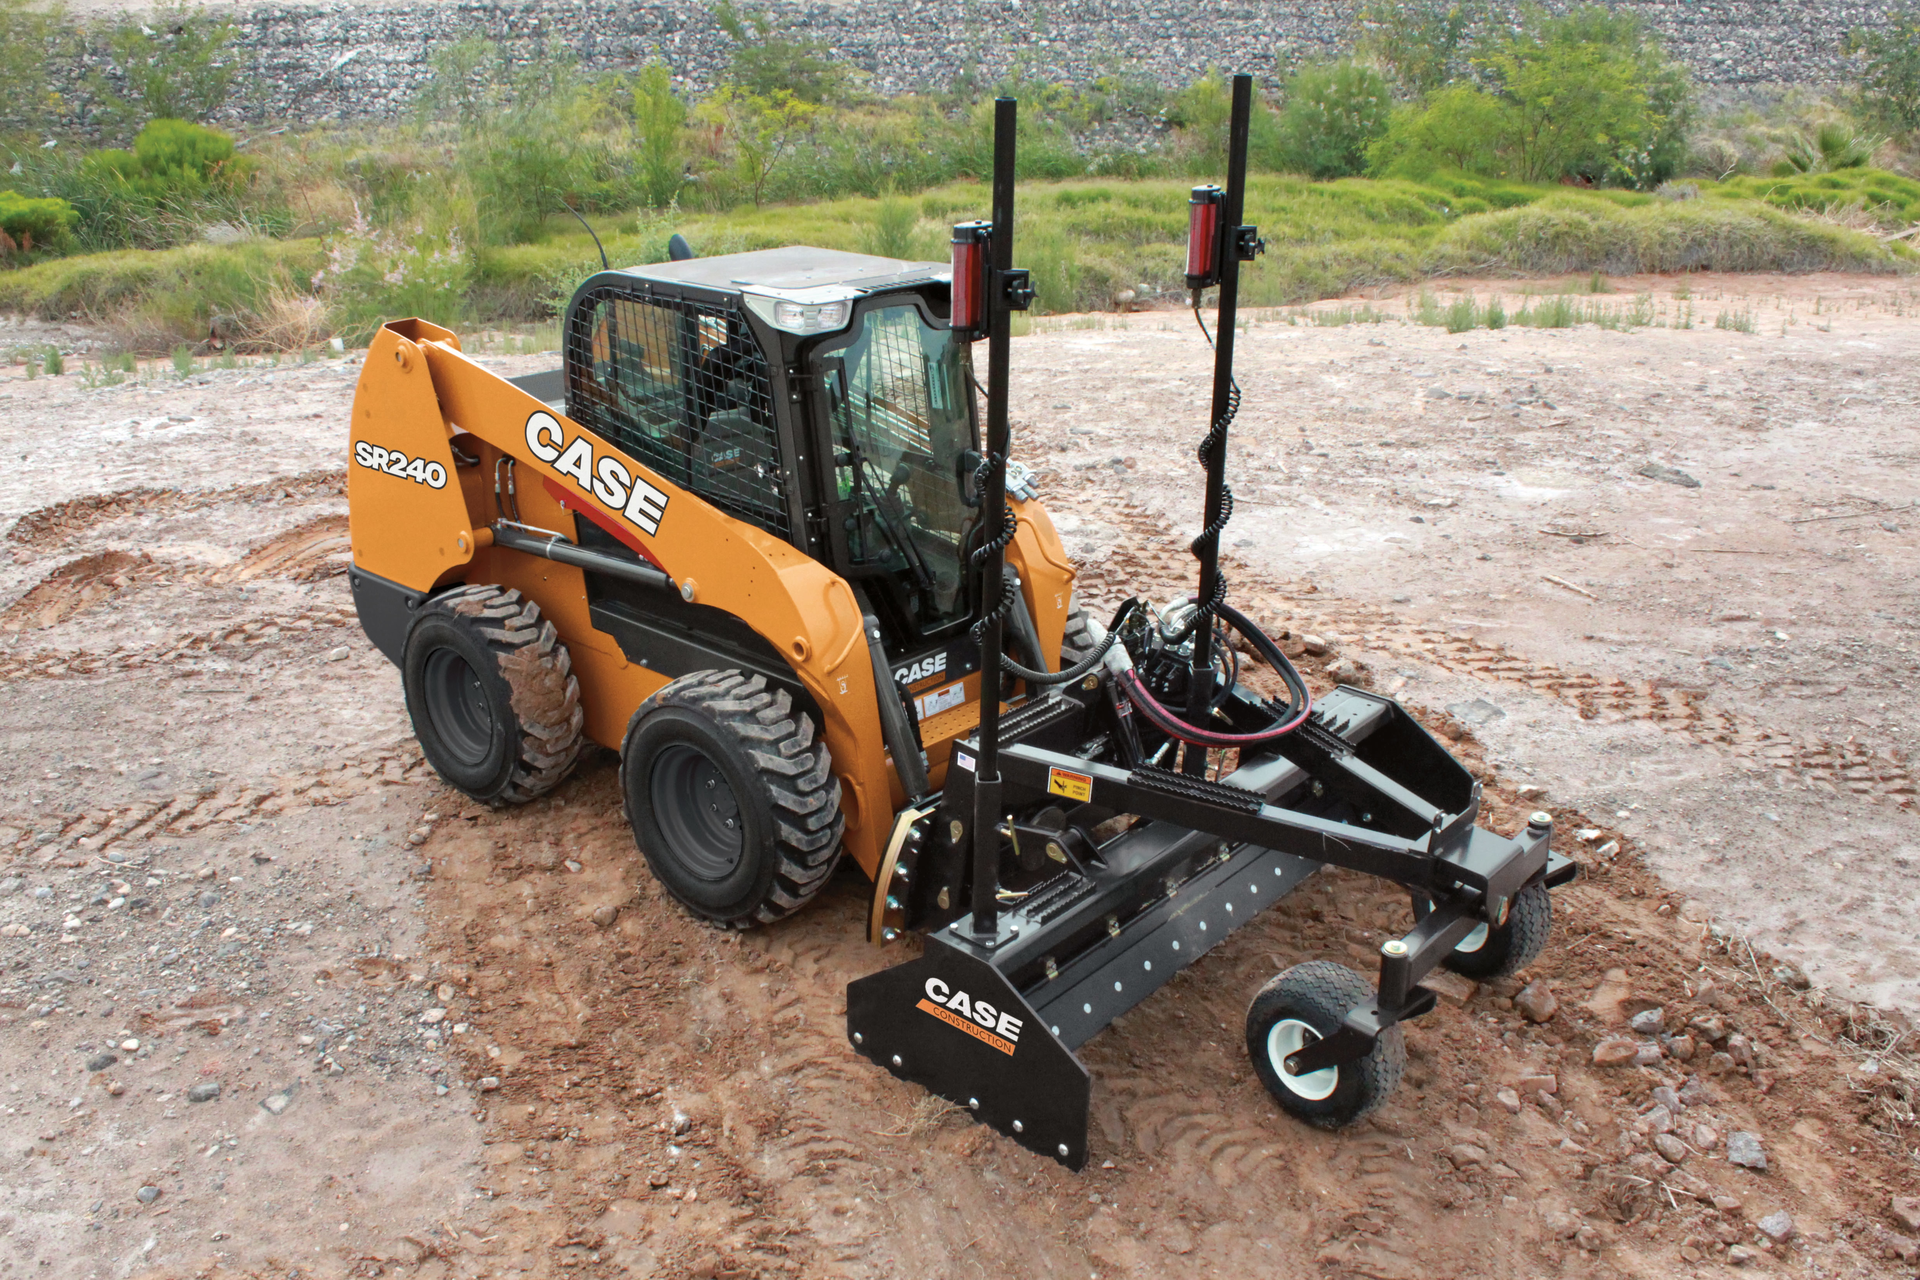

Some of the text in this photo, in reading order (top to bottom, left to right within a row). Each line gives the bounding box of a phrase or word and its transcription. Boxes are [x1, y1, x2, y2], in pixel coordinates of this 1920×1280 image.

[354, 440, 447, 490] SR240
[525, 410, 670, 538] CASE
[894, 652, 947, 685] CASE
[909, 674, 944, 691] NSTRUCTION
[1062, 772, 1087, 783] WARNING
[925, 977, 1024, 1042] CASE
[933, 1007, 1012, 1053] CONSTRUCTION
